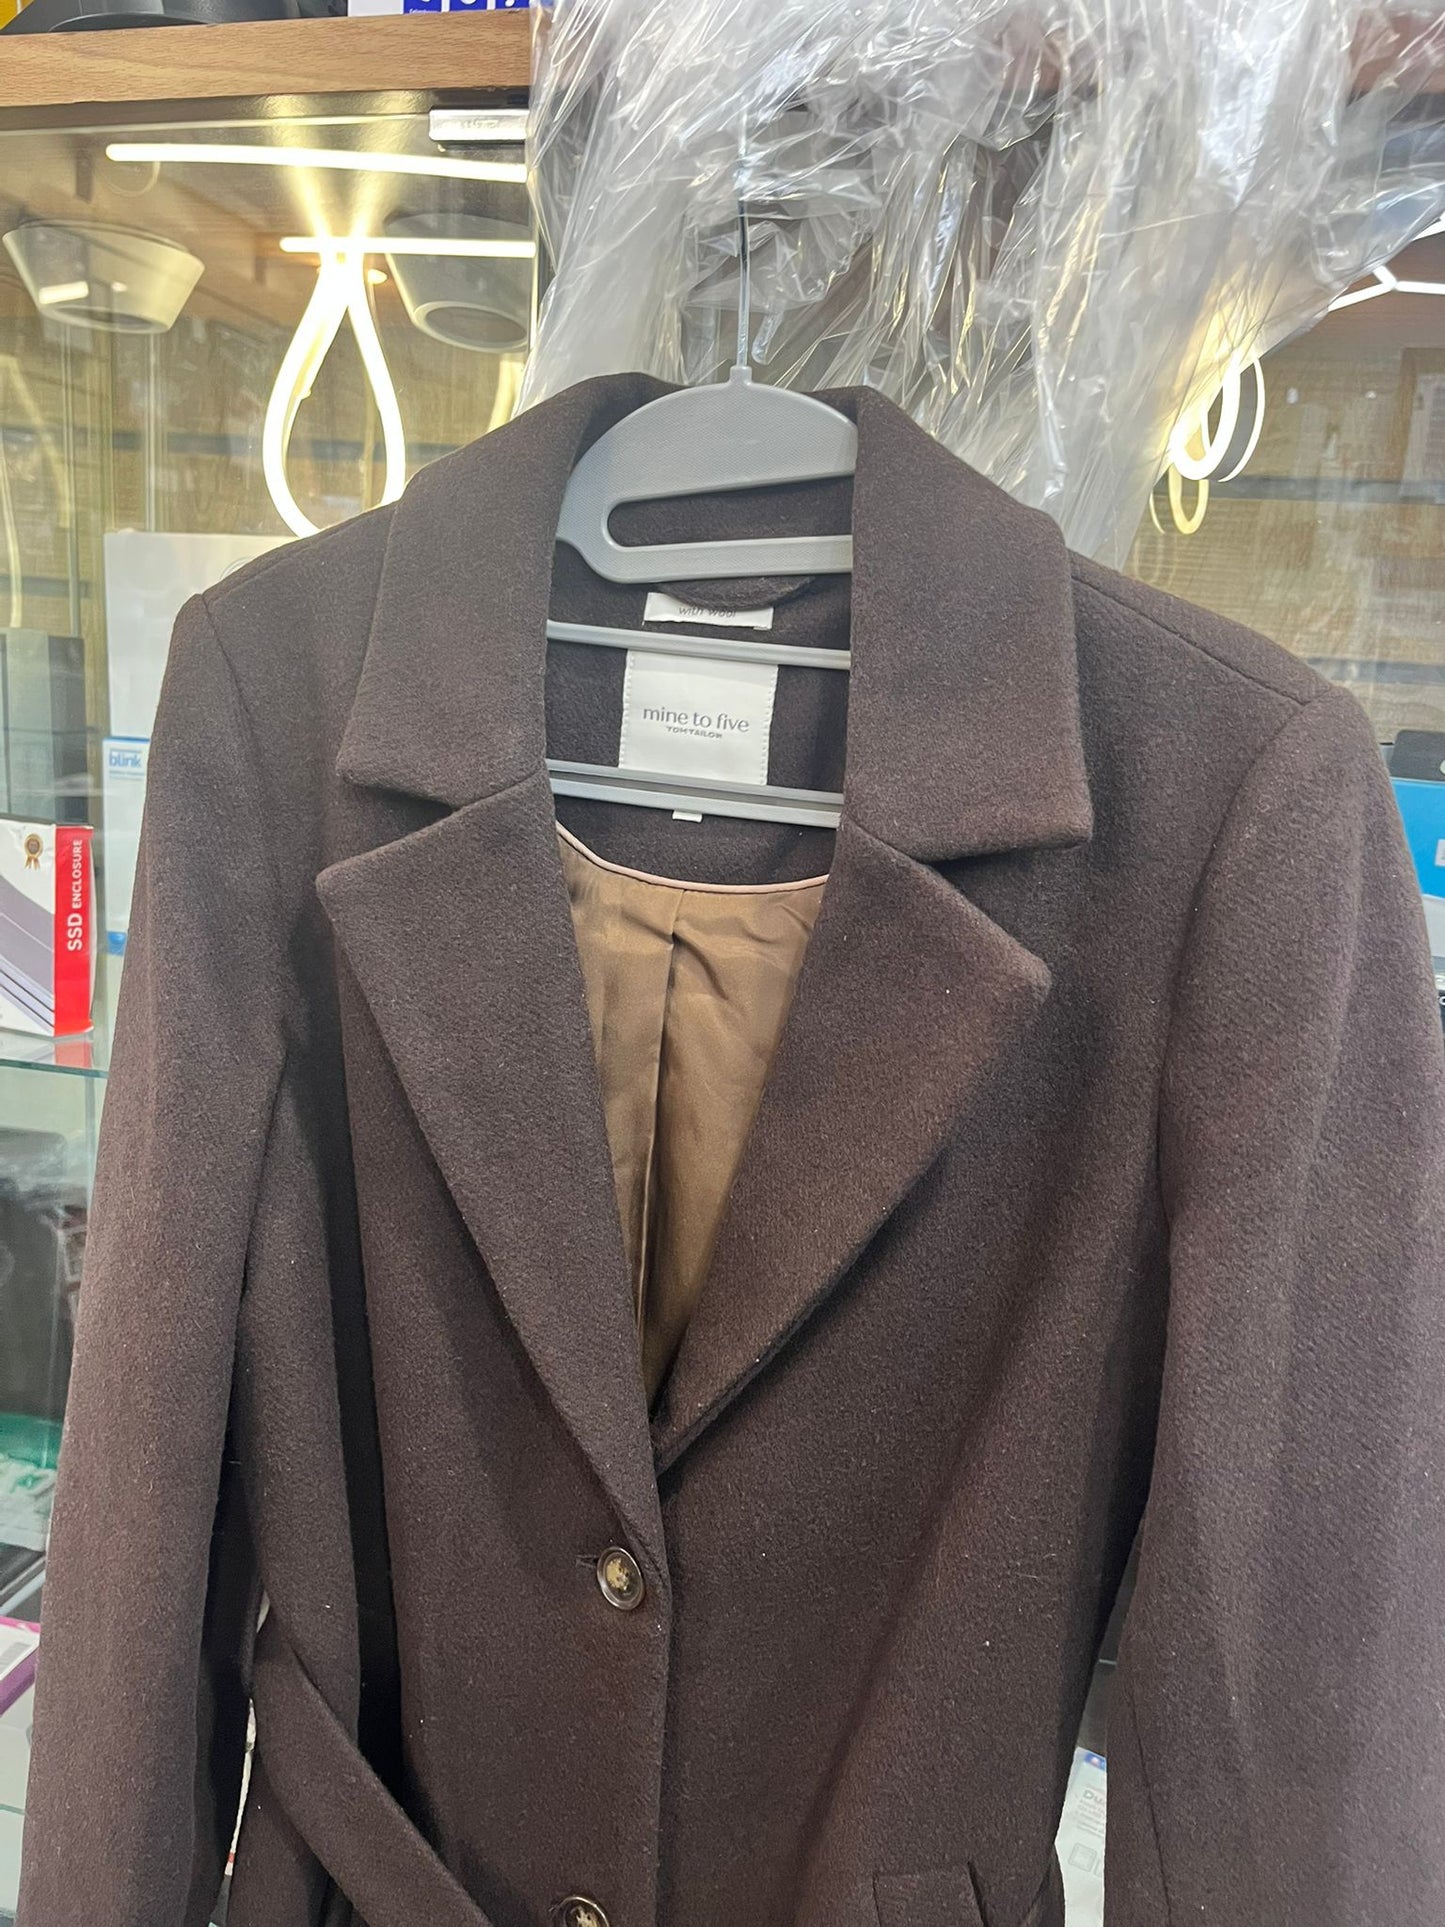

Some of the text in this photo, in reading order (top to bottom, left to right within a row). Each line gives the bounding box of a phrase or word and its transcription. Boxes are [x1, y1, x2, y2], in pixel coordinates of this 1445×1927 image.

[643, 706, 750, 733] mine to five
[109, 751, 142, 768] blink
[67, 839, 83, 952] SSD ENCLOSURE
